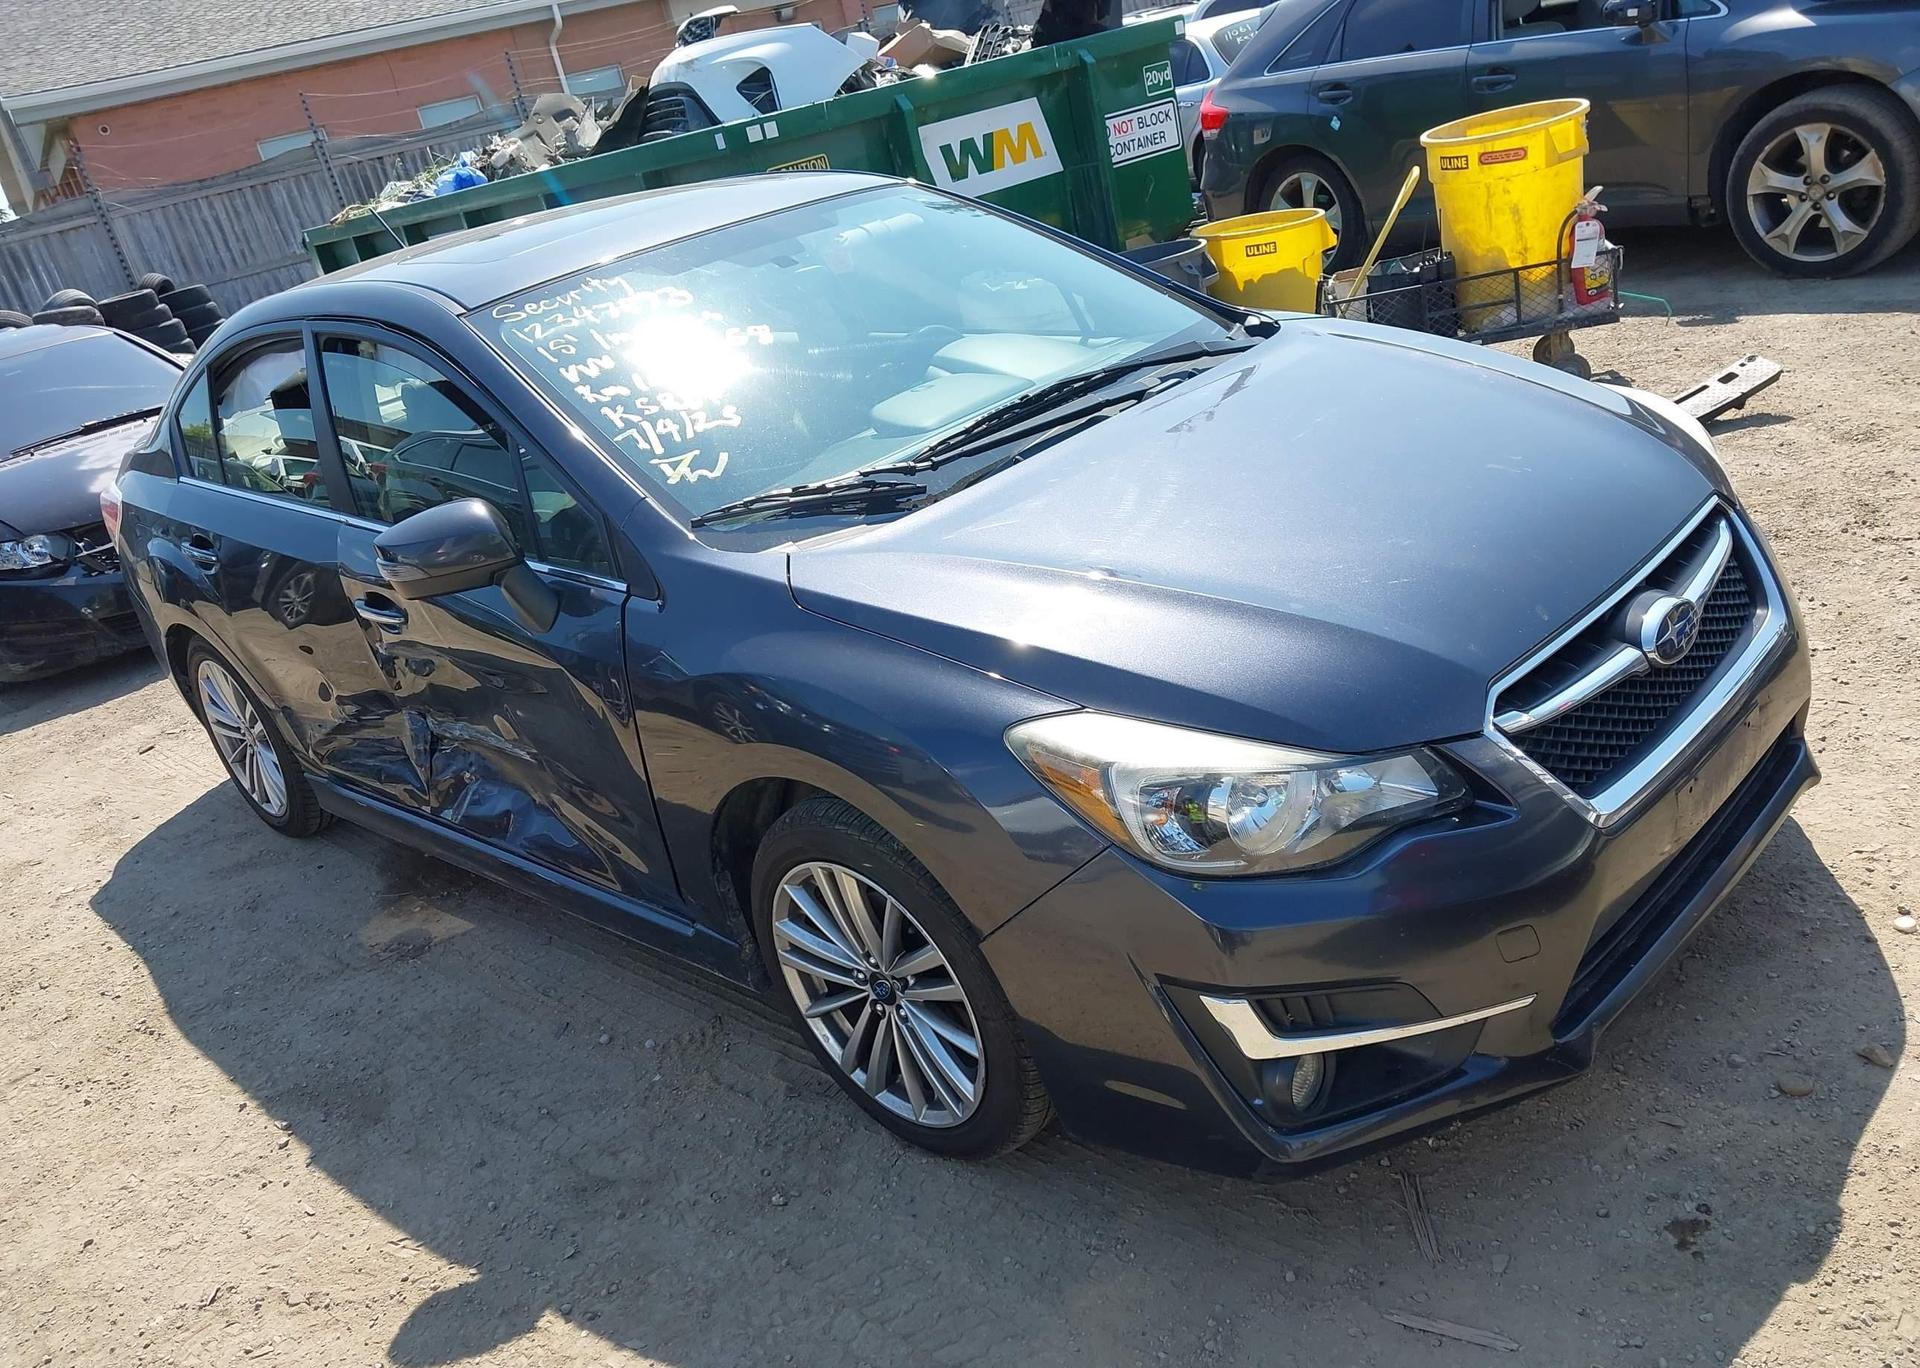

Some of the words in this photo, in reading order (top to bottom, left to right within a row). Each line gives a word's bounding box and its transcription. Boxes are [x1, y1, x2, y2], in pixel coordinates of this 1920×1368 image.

[1145, 66, 1172, 87] 20yd
[1113, 119, 1135, 137] NOT
[1137, 108, 1173, 130] BLOCK
[939, 121, 1044, 182] WM
[1440, 155, 1469, 170] ULINE
[1245, 241, 1277, 257] ULINE
[492, 276, 634, 323] Security
